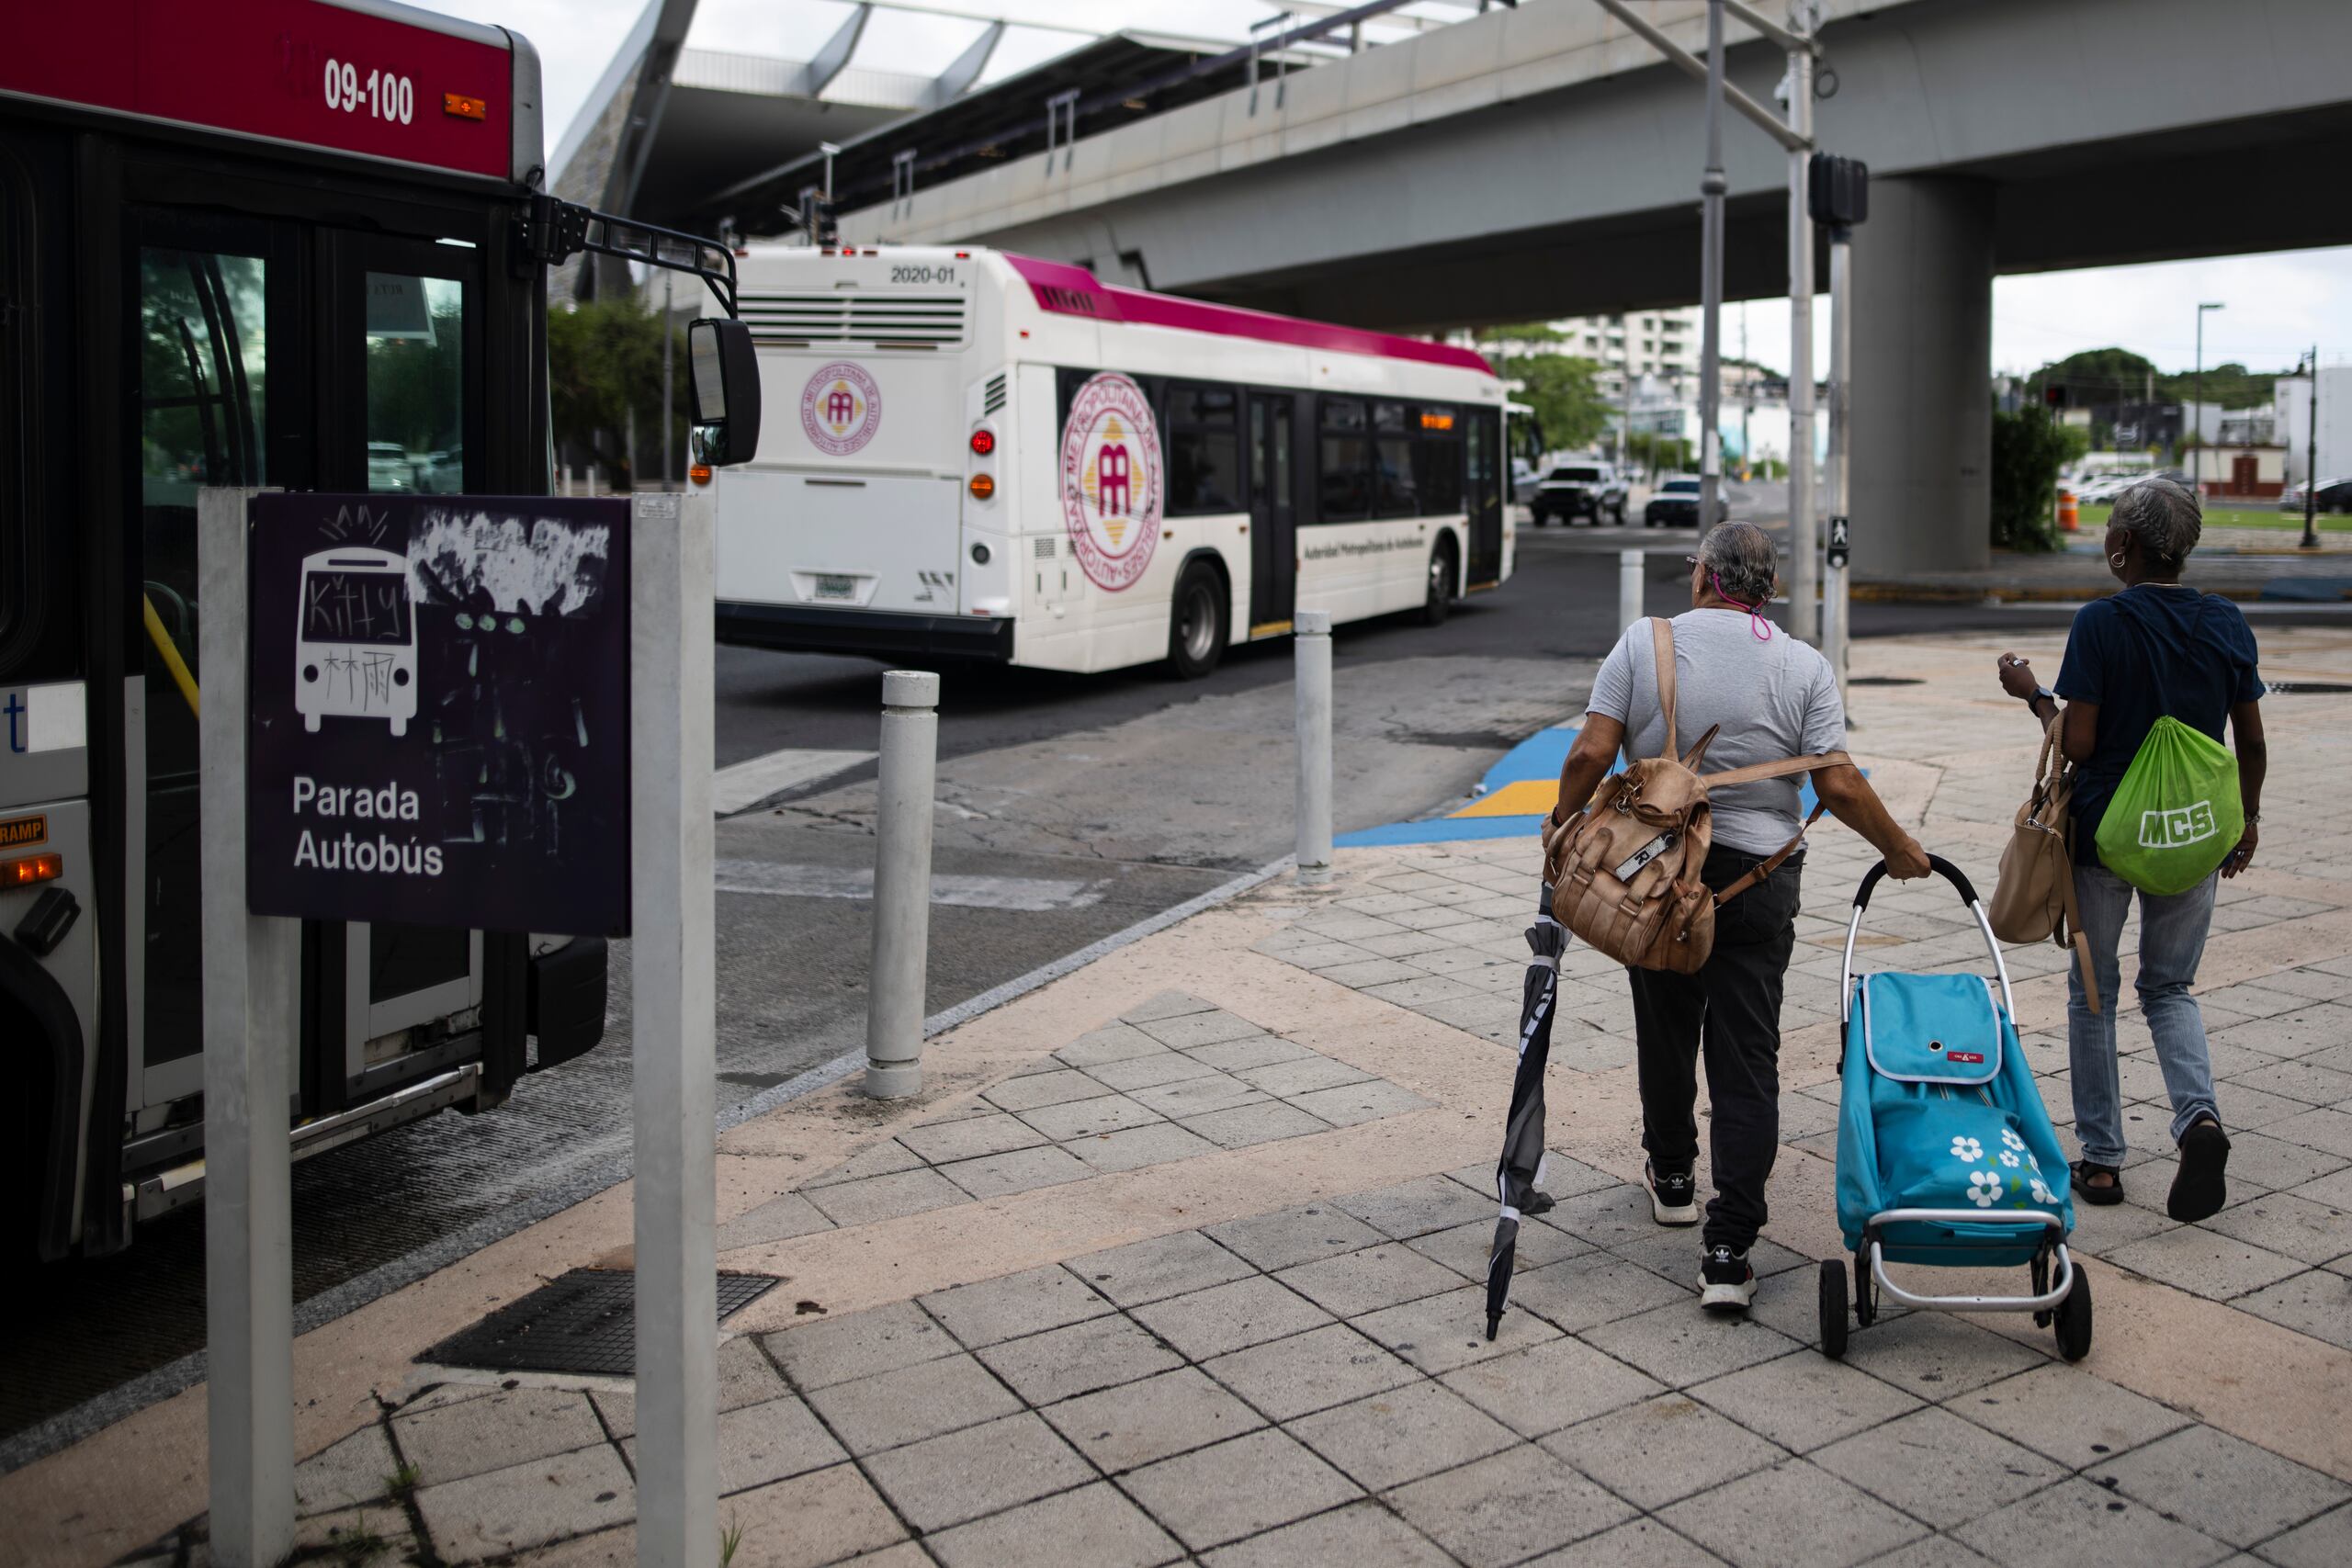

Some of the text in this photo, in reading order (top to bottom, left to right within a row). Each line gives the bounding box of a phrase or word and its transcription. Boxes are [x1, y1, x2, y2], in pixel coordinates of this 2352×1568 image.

[324, 58, 413, 126] 09-100
[891, 265, 955, 285] 2020-01
[1066, 382, 1144, 476] METROPOLITANA
[293, 775, 420, 821] Parada
[0, 822, 41, 843] RAMP
[2141, 802, 2213, 846] MCS
[294, 829, 444, 876] Autobús
